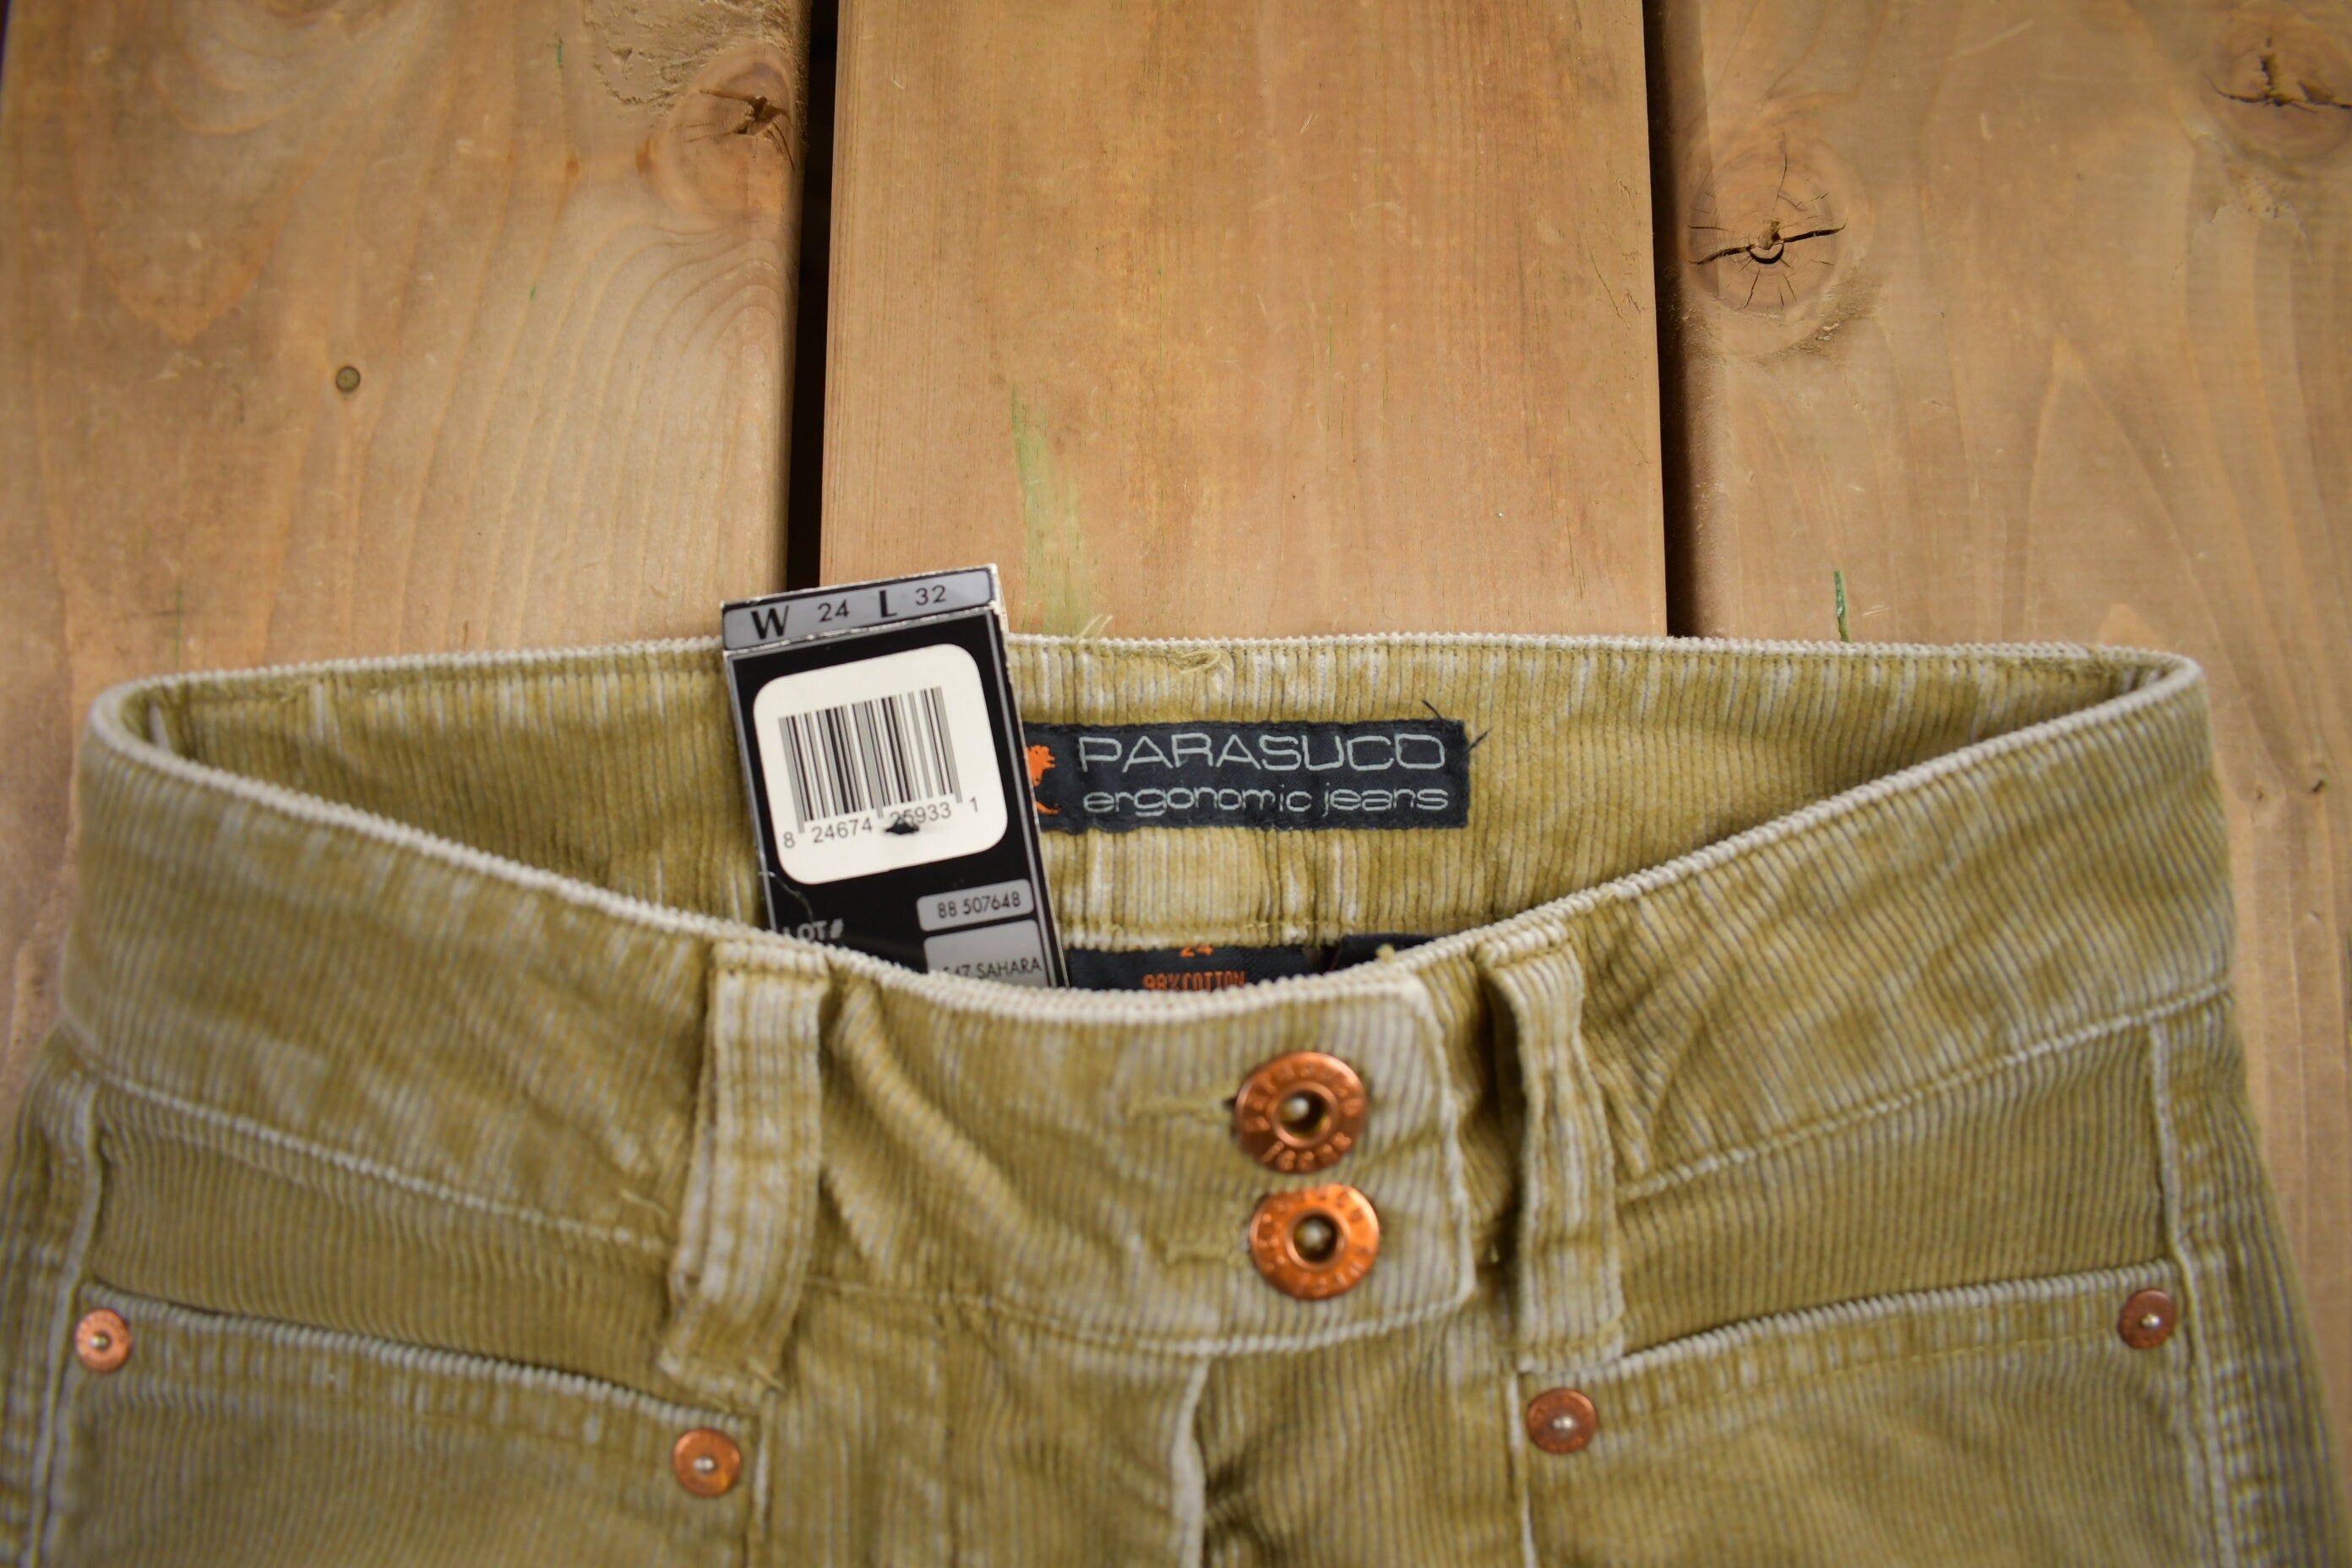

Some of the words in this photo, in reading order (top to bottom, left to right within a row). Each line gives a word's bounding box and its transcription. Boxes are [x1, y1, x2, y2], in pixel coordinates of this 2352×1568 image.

[751, 604, 789, 640] W
[817, 600, 851, 623] 24
[879, 590, 898, 618] L
[915, 585, 946, 606] 32
[1078, 732, 1446, 773] PARASUCO
[1082, 784, 1312, 818] ergonomic
[1322, 782, 1449, 818] jeans
[782, 831, 796, 849] 8
[811, 817, 873, 843] 24674
[969, 797, 978, 813] 1
[937, 900, 957, 919] 88
[962, 891, 1021, 915] 507648
[976, 957, 1042, 979] SAHARA
